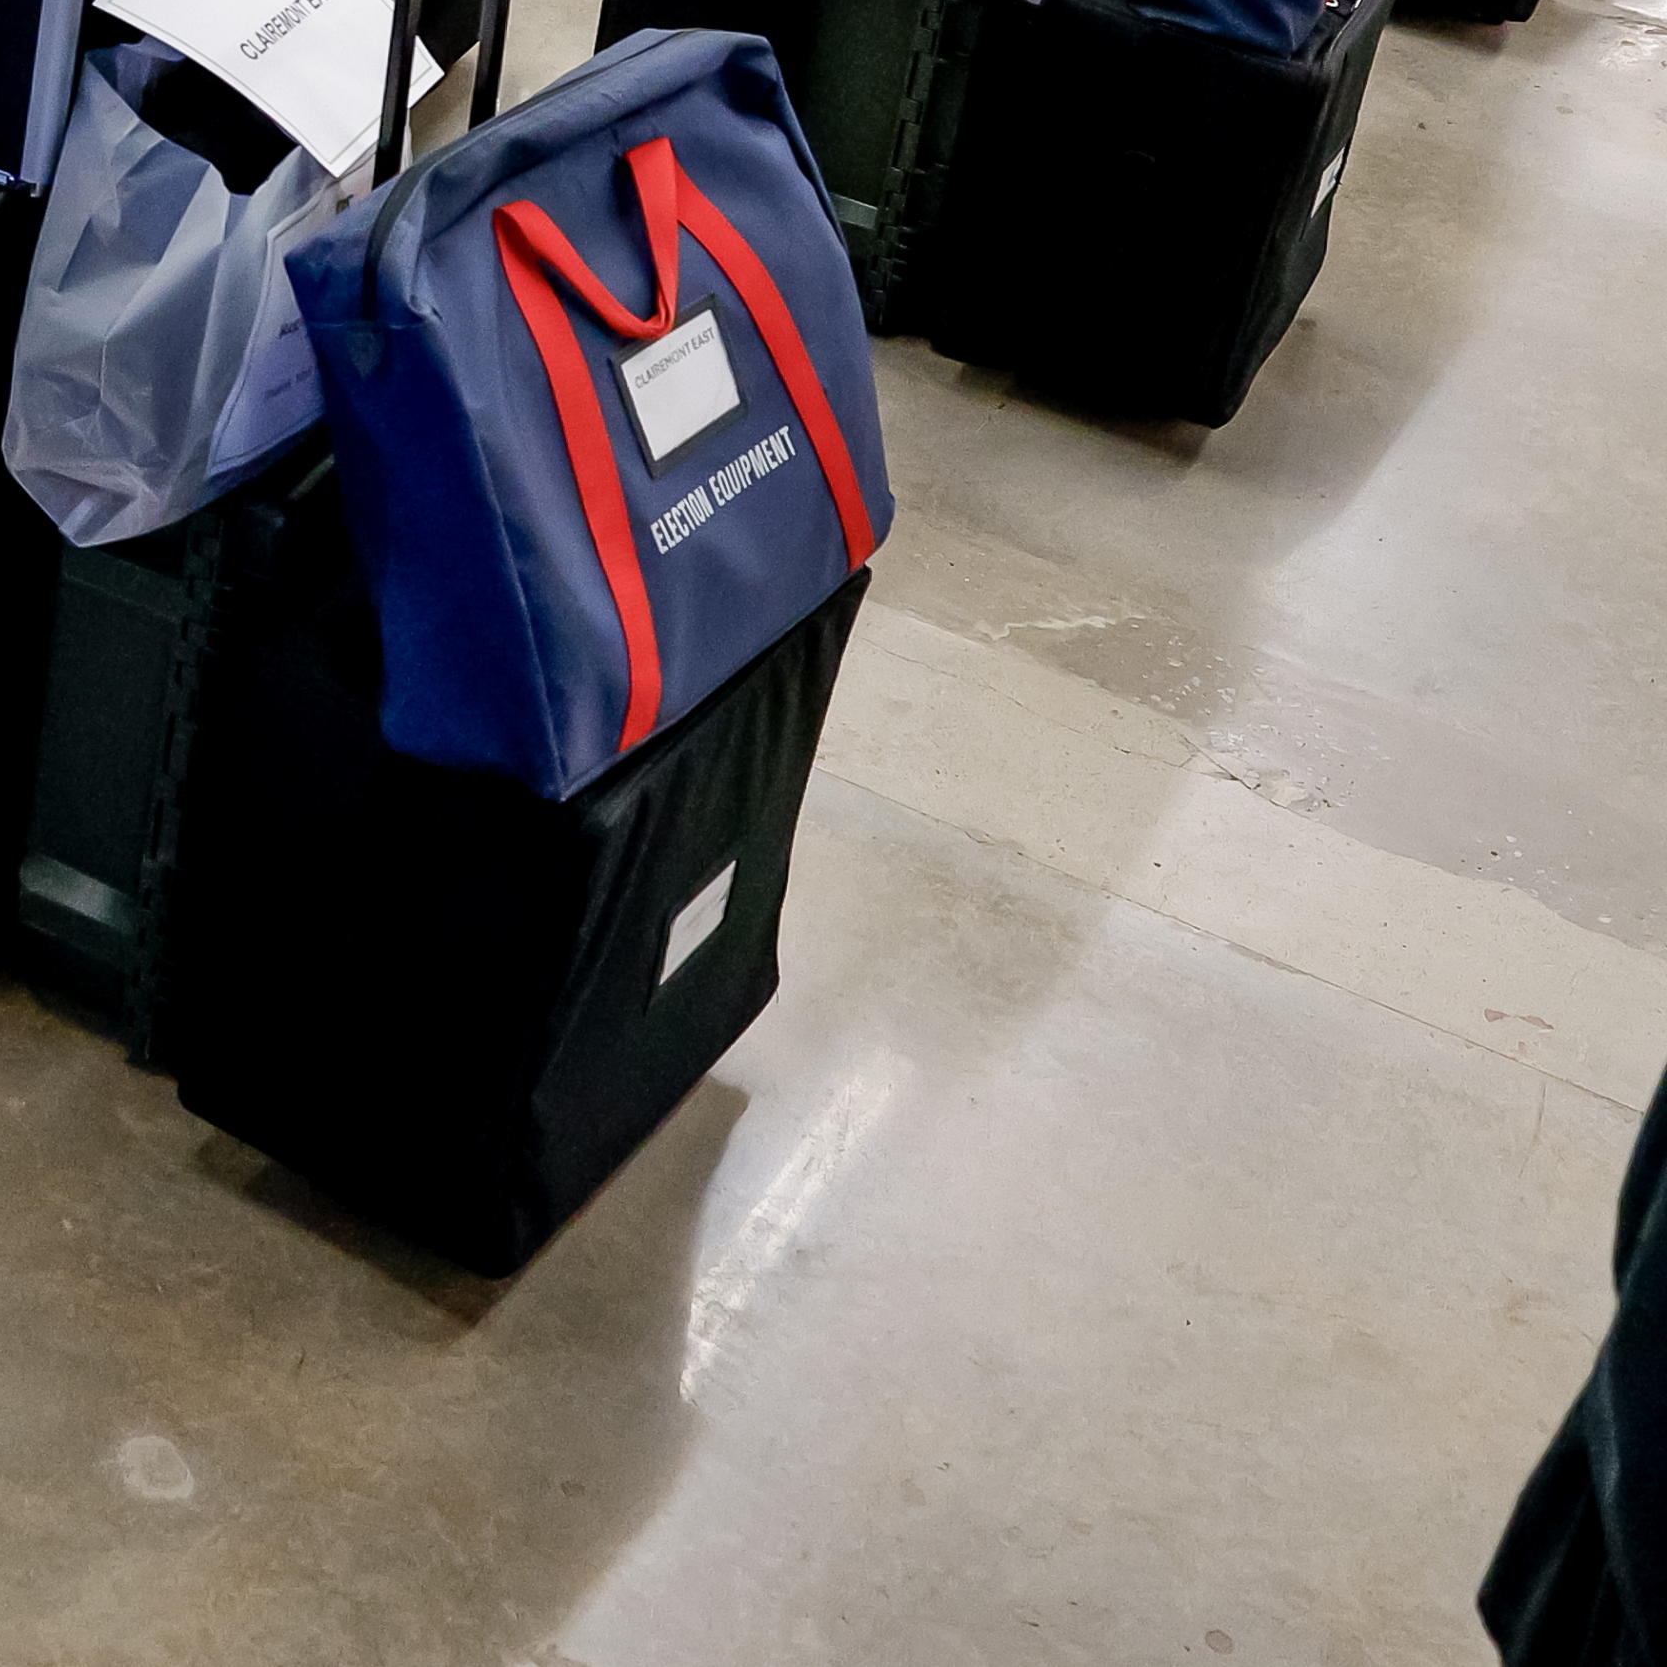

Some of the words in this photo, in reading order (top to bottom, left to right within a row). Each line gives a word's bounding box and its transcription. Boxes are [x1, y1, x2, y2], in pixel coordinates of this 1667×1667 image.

[634, 341, 692, 391] CLAIREMONT
[690, 325, 716, 350] EAST
[650, 474, 717, 554] ELECTION
[707, 425, 796, 509] EQUIPMENT
